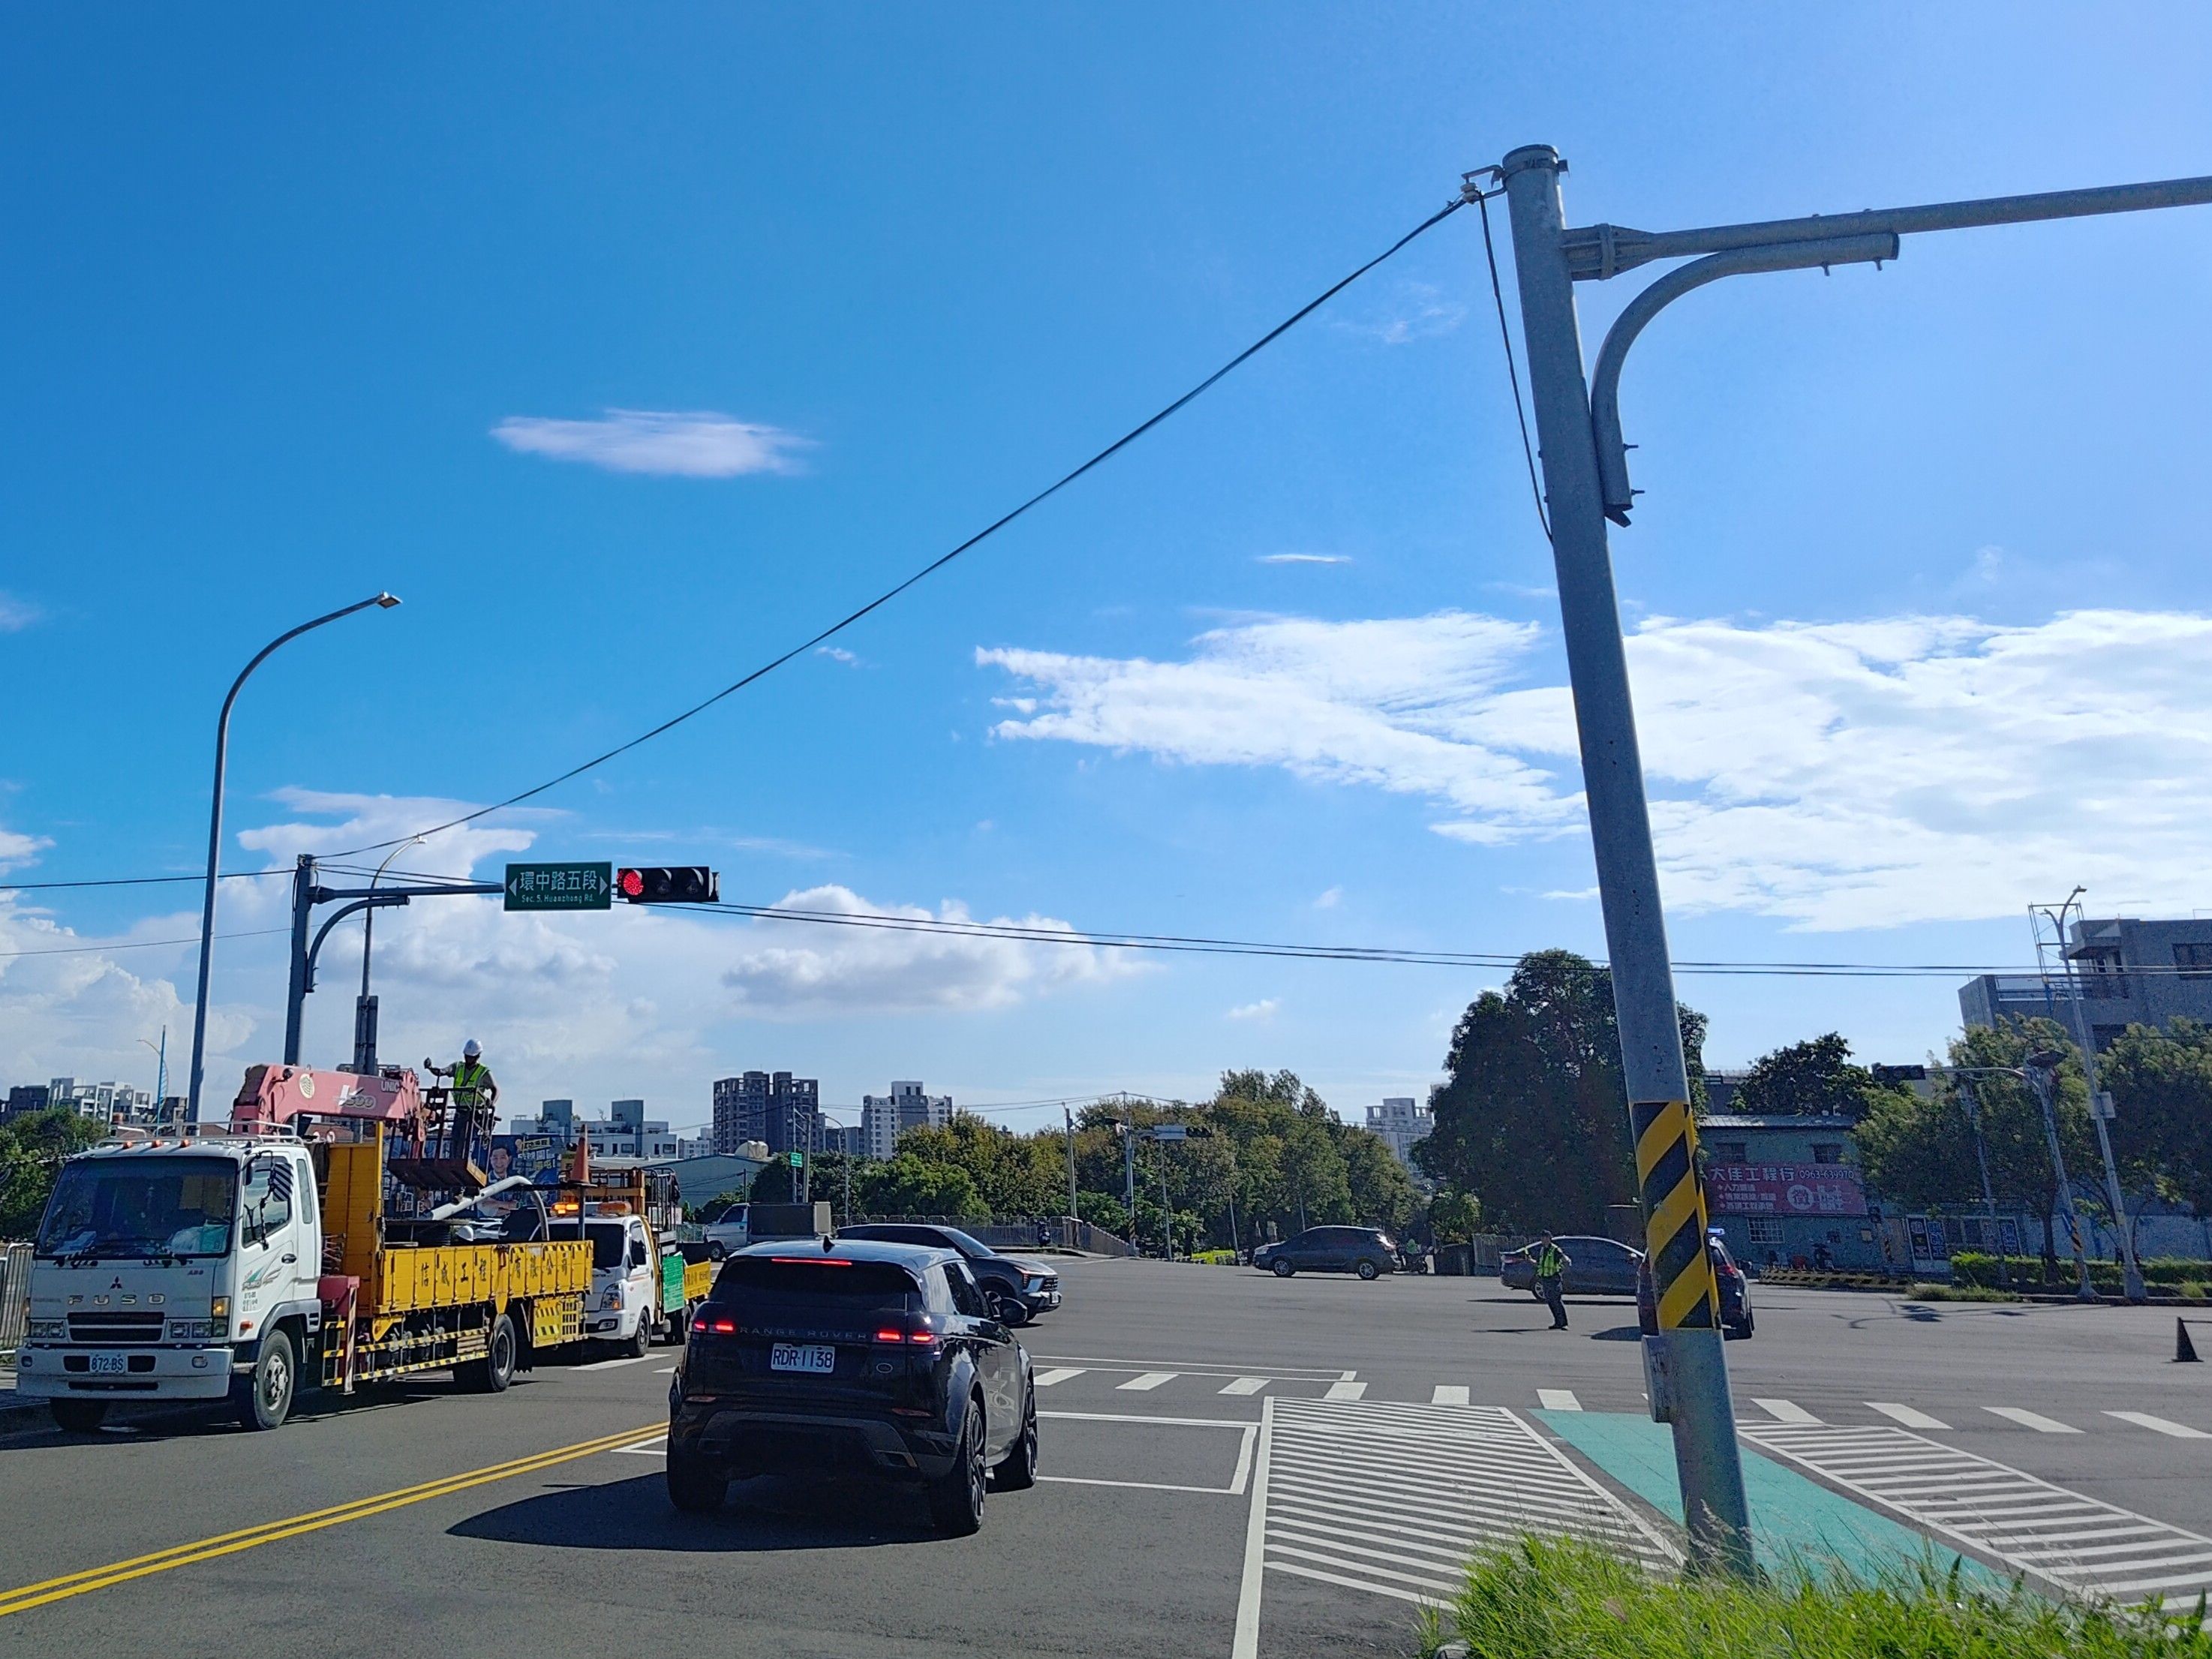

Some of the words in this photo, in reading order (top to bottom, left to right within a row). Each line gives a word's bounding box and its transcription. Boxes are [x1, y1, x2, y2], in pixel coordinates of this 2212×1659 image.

[519, 870, 597, 891] 環中路五段
[521, 894, 535, 903] Sec.
[584, 894, 595, 902] Rd.
[380, 1080, 401, 1093] UNIC
[1710, 1167, 1795, 1182] 大佳工程行
[67, 1293, 166, 1306] FUSO
[739, 1327, 797, 1336] RANGE
[807, 1330, 867, 1339] ROVER
[91, 1357, 124, 1371] 872-BS
[772, 1348, 834, 1369] RDR-1138
